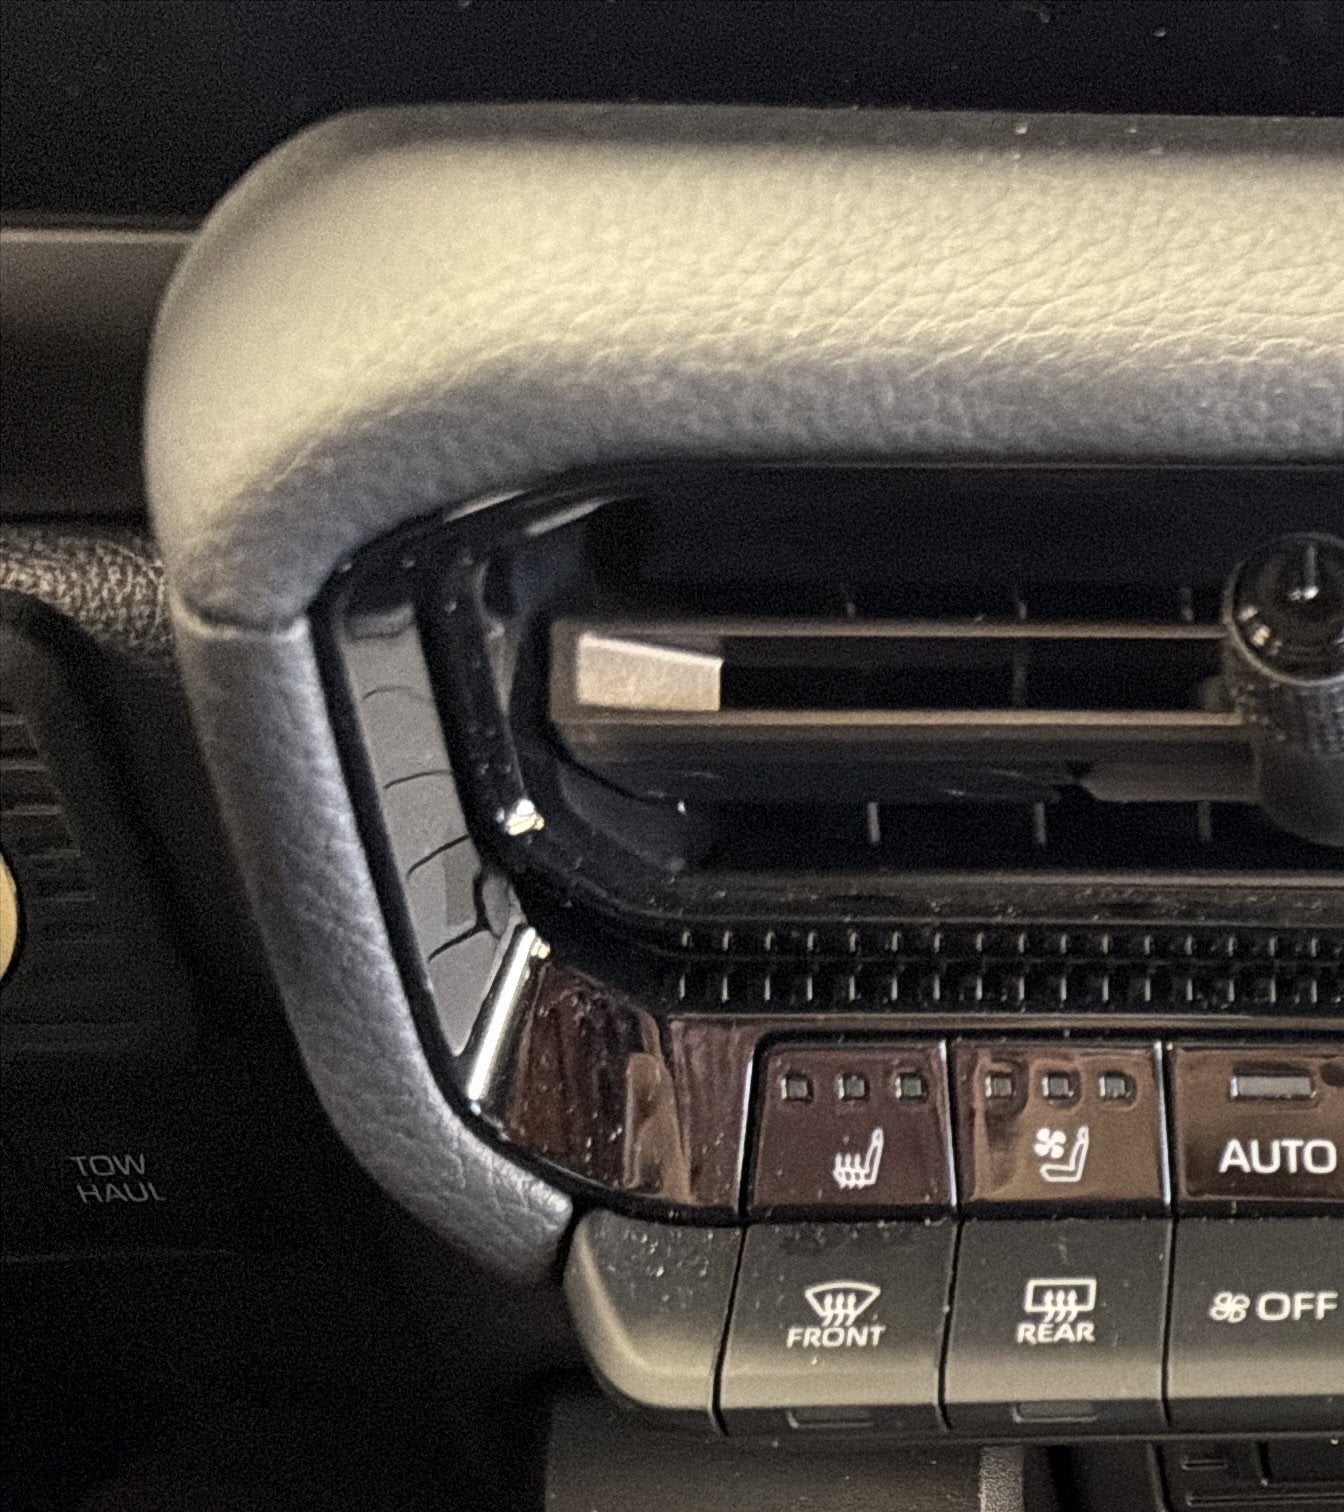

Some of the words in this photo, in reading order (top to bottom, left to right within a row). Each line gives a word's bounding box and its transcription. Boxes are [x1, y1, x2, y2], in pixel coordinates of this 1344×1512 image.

[69, 1152, 146, 1177] TOW
[1219, 1138, 1337, 1174] AUTO
[76, 1181, 166, 1204] HAUL
[1256, 1290, 1338, 1321] OFF
[786, 1325, 886, 1348] FRONT
[1017, 1321, 1095, 1344] REAR
